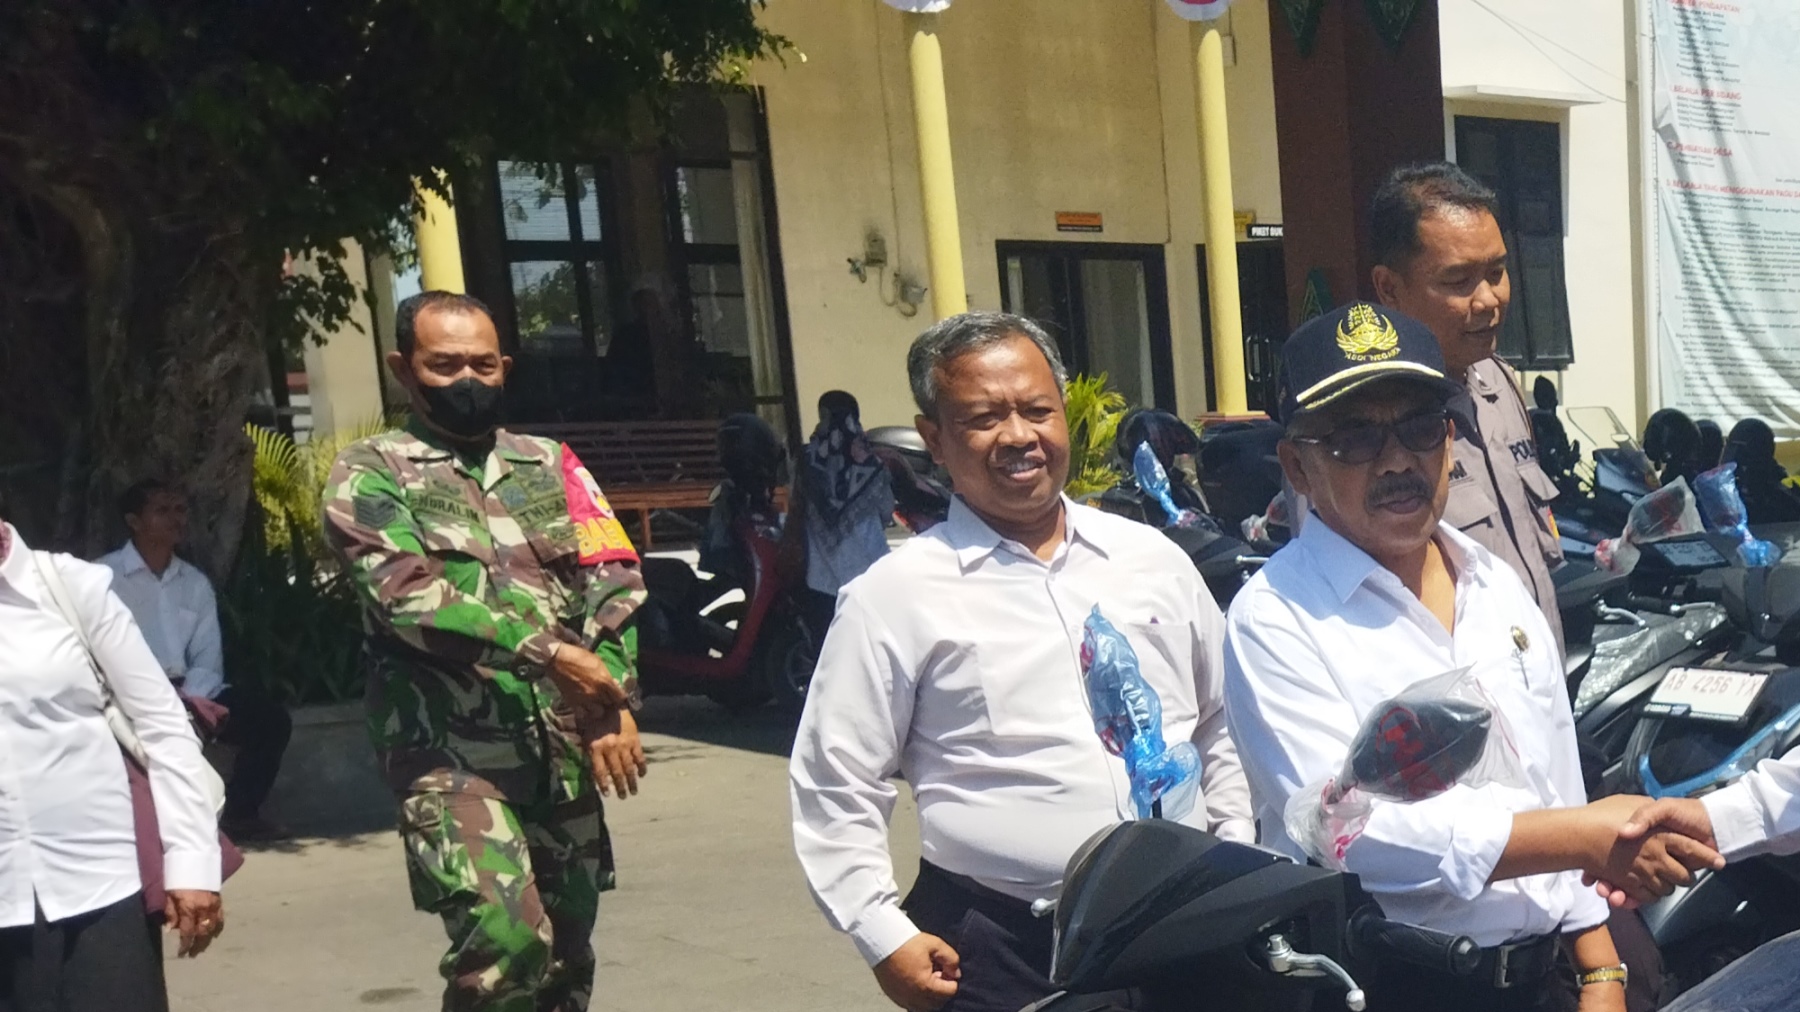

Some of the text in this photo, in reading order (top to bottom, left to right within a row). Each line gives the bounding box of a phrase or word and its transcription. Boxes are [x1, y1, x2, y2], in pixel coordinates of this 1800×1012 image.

[1664, 671, 1761, 697] AB 4256 YX
